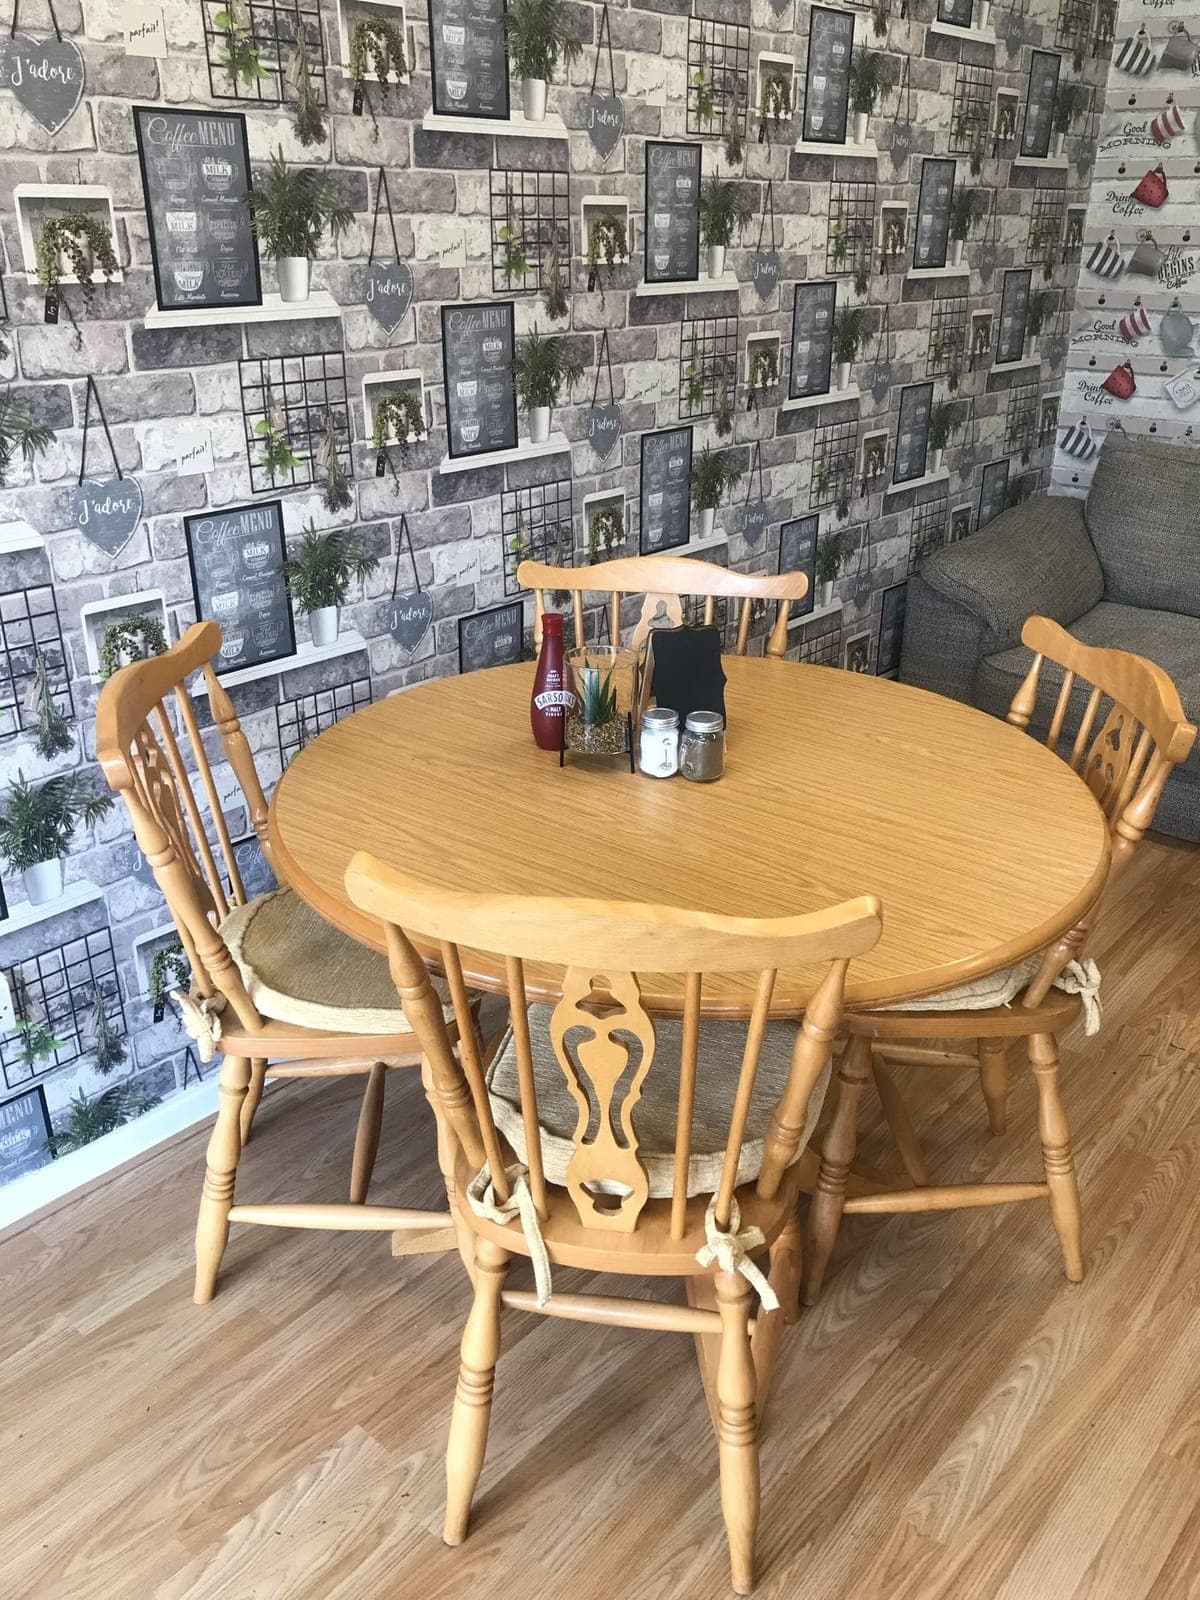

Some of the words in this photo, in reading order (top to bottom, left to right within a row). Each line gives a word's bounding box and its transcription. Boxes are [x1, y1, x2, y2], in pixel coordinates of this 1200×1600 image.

[11, 56, 76, 86] J'adore
[148, 117, 197, 152] Coffee
[198, 121, 235, 146] MENU
[1123, 122, 1147, 137] Good
[206, 165, 229, 175] MILK
[1113, 203, 1144, 217] Coffee
[367, 278, 406, 301] J'adore
[449, 311, 481, 336] Coffee
[482, 309, 507, 328] MENU
[1094, 320, 1116, 333] Good
[1084, 392, 1113, 405] Coffee
[79, 497, 133, 524] J'adore
[197, 520, 240, 546] Coffee
[240, 510, 273, 534] MENU
[391, 606, 426, 630] J'adore
